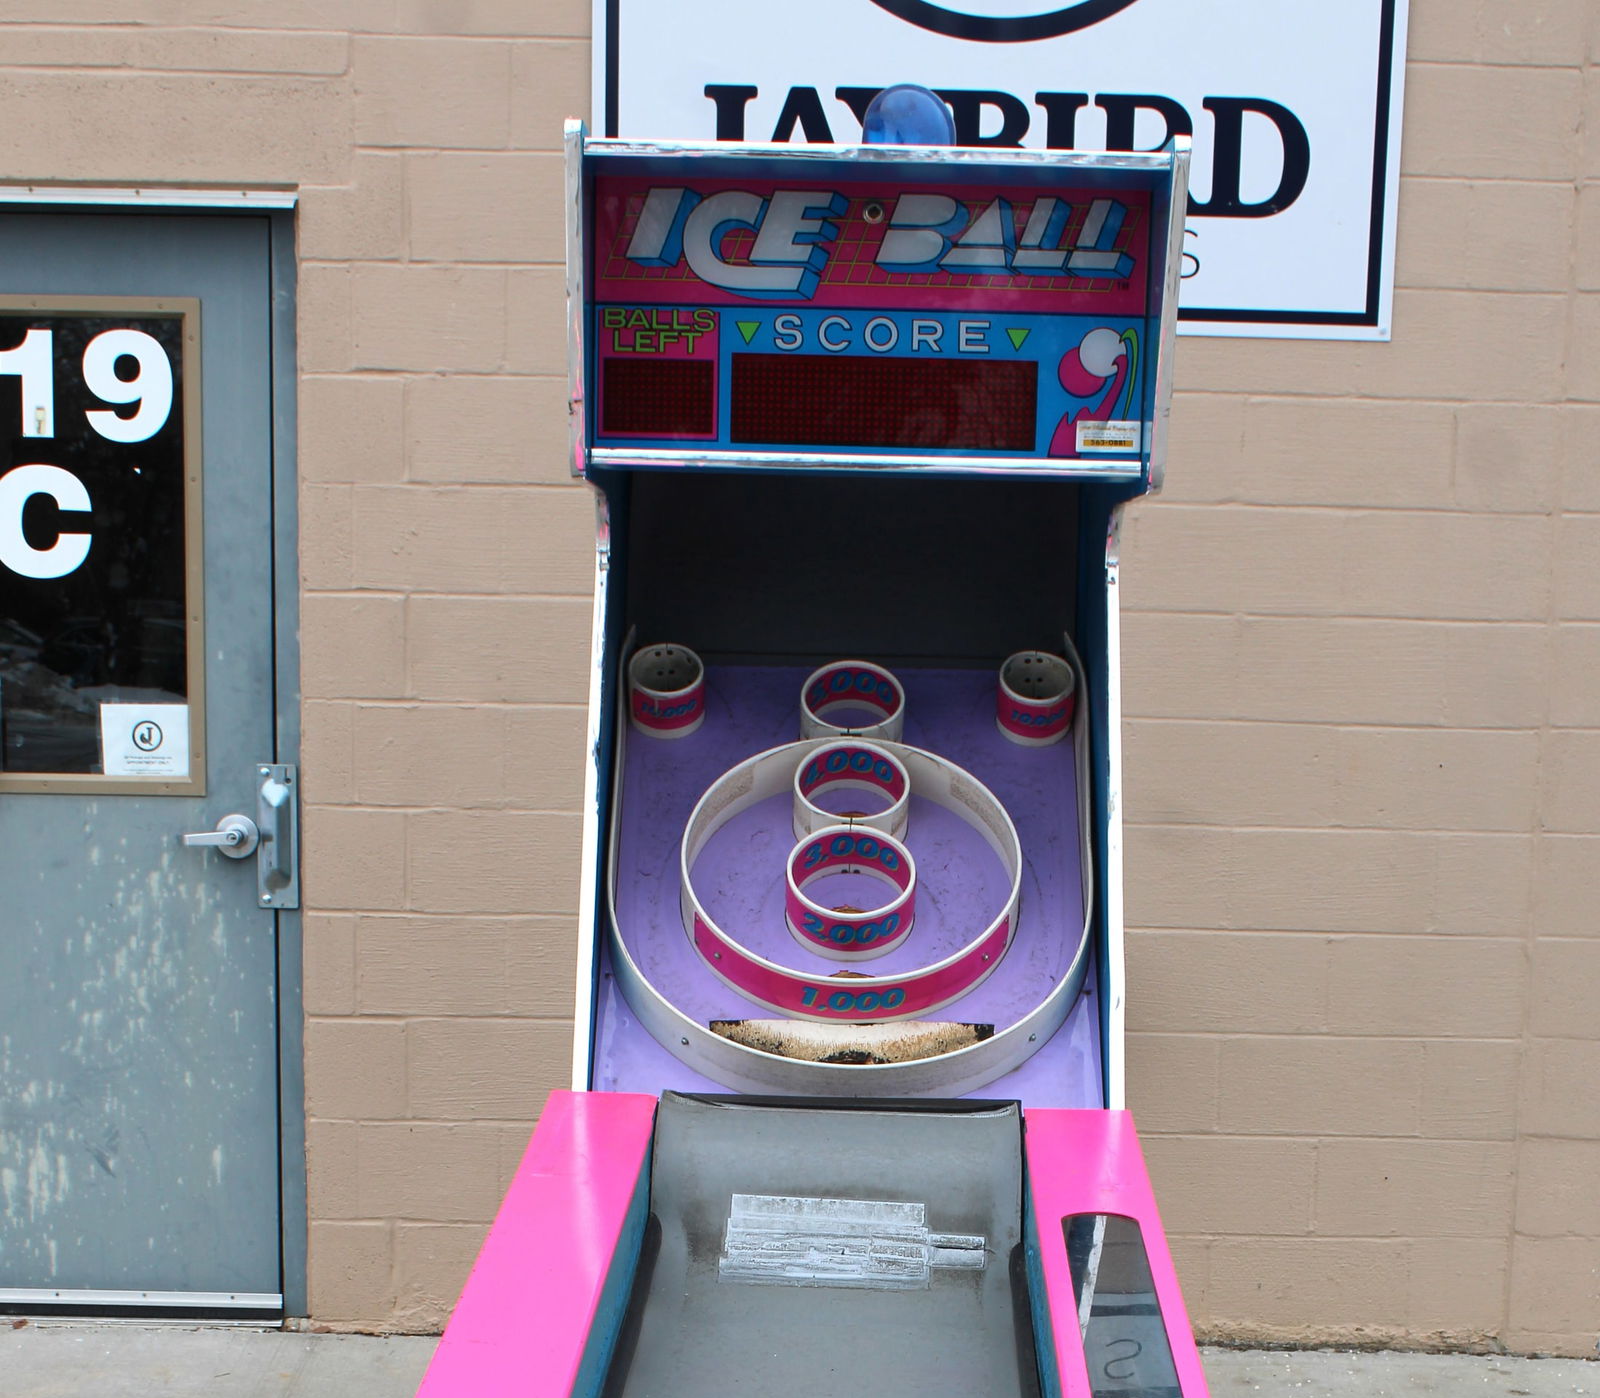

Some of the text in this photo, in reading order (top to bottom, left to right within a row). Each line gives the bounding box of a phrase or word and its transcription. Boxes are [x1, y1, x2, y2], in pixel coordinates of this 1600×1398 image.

[626, 187, 1136, 301] ICE BALL
[604, 308, 716, 333] BALLS
[773, 313, 992, 353] SCORE
[613, 329, 703, 354] LEFT
[0, 463, 93, 579] C
[810, 670, 894, 710] 5,000
[803, 751, 894, 787] 4,000
[804, 836, 899, 871] 3,000
[802, 912, 901, 945] 2,000
[800, 986, 906, 1013] 1,000
